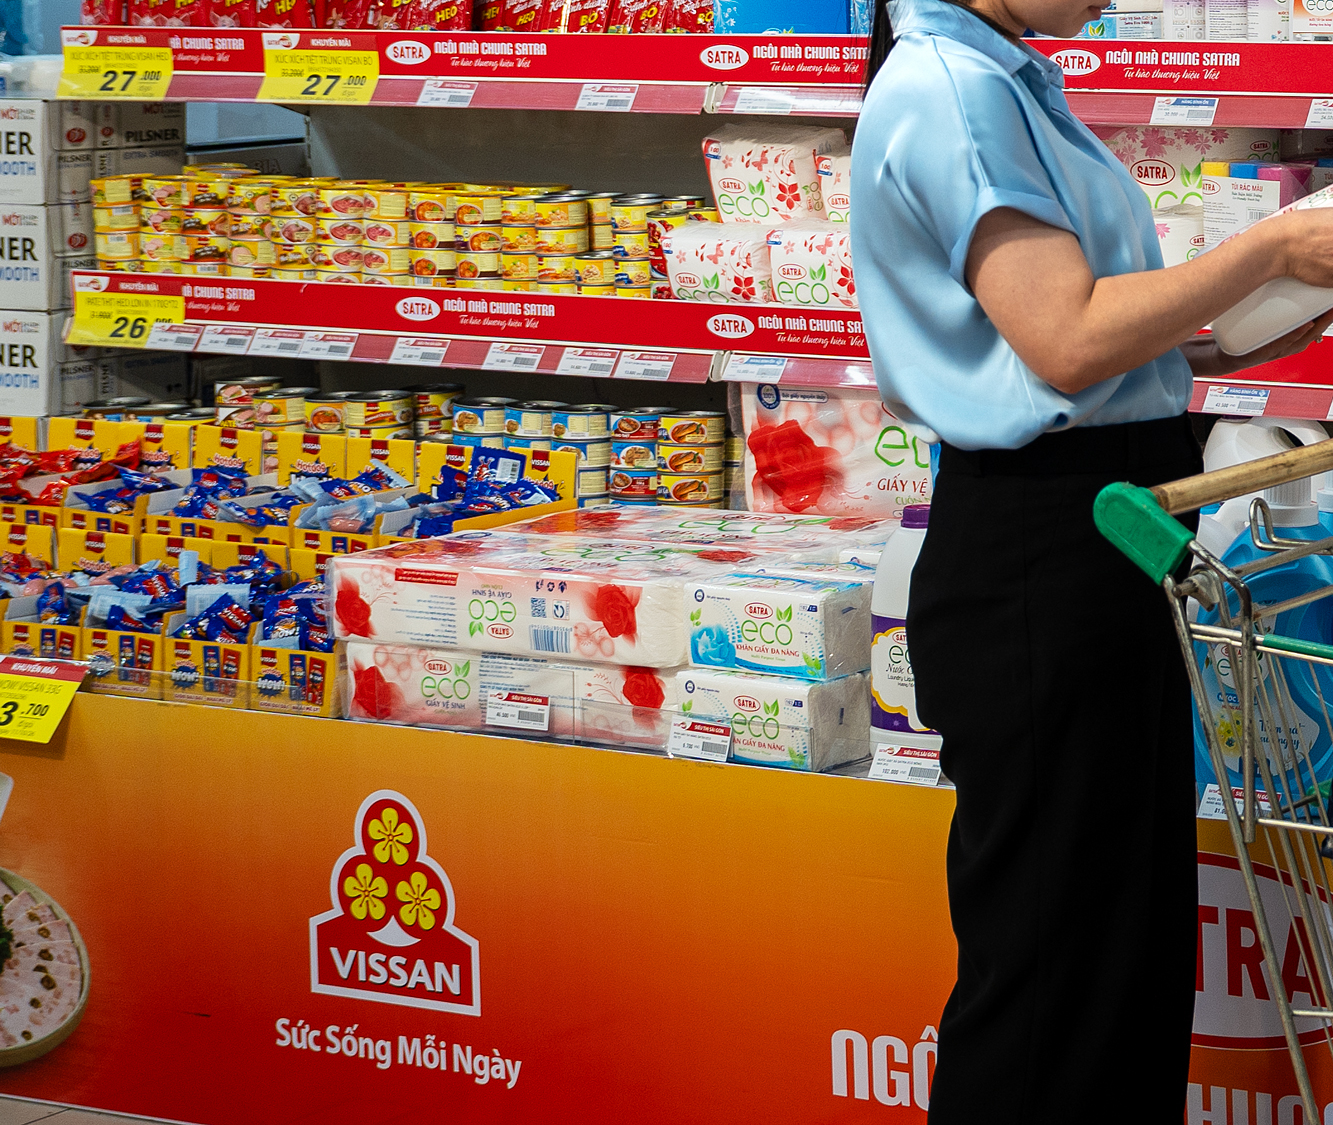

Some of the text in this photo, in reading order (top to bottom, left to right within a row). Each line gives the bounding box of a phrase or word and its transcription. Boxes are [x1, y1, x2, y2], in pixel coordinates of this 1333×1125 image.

[99, 70, 137, 92] 27
[301, 75, 341, 95] 27
[125, 129, 180, 143] PILSNER
[110, 317, 146, 339] 26
[749, 606, 768, 616] SATRA
[741, 620, 793, 645] eco
[736, 643, 753, 652] KHĂN
[755, 644, 769, 654] GIẤY
[781, 647, 799, 657] NĂNG
[330, 947, 461, 996] VISSAN
[275, 1018, 522, 1090] Sức Sống Mỗi Ngày
